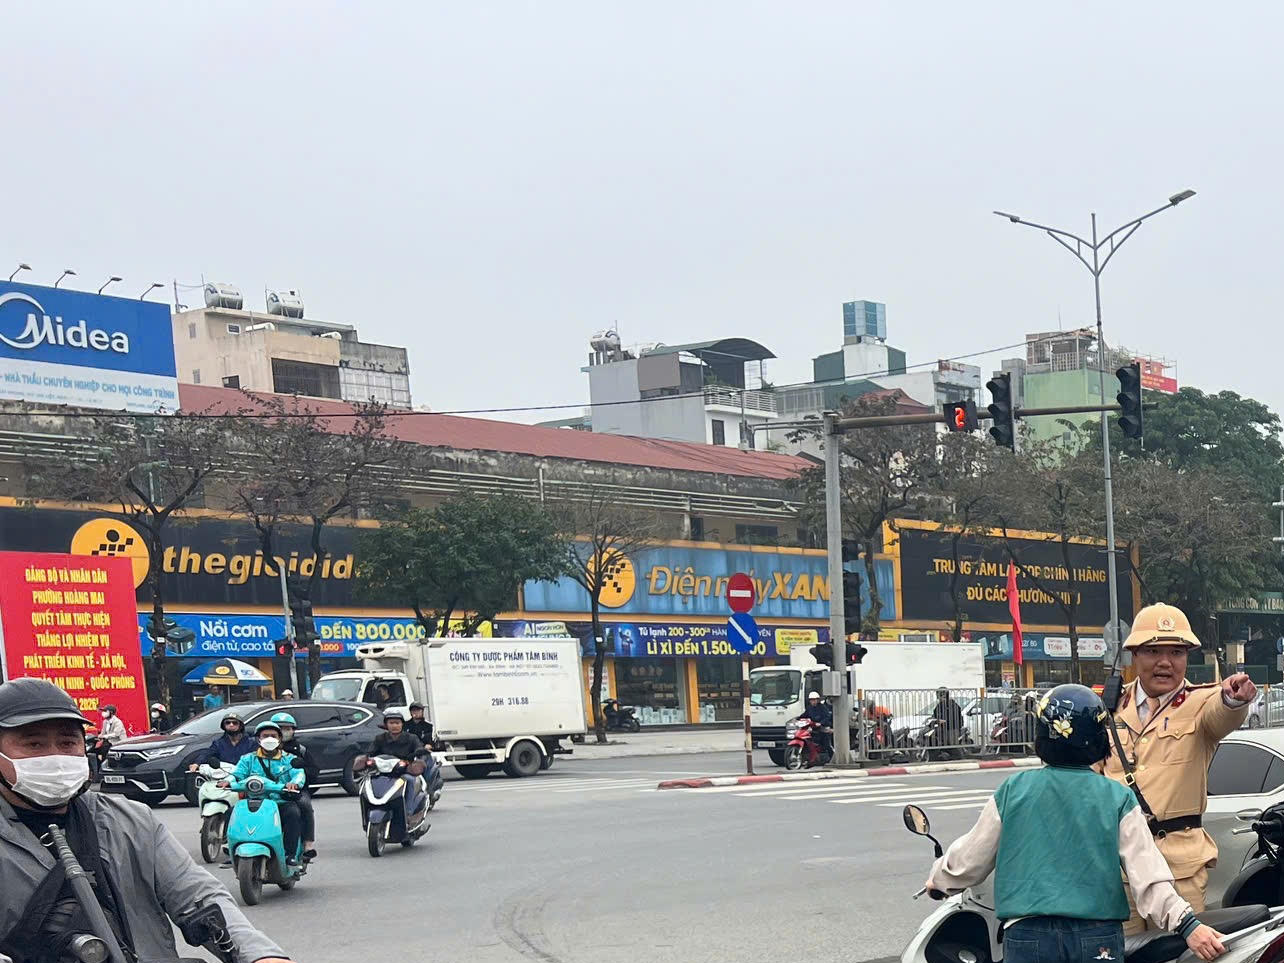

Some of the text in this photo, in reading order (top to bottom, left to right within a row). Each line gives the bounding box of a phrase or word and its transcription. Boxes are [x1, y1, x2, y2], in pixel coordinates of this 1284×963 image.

[15, 312, 130, 354] Midea
[25, 565, 47, 582] ĐẢNG
[59, 567, 70, 582] VÀ
[70, 567, 91, 583] NHÂN
[92, 568, 108, 584] DÂN
[645, 565, 712, 604] Điện
[985, 584, 1008, 602] CÁC
[32, 588, 105, 605] PHƯỜNG HOÀNG MAI
[32, 609, 111, 628] QUYẾT TÂM THỰC HIỆN
[200, 619, 268, 638] Nồi cơm
[320, 621, 353, 640] ĐẾN
[638, 626, 649, 637] Tủ
[649, 627, 667, 640] lạnh
[36, 630, 62, 648] THẮNG
[75, 632, 100, 649] NHIỆM
[100, 634, 111, 650] VỤ
[201, 640, 225, 653] điện
[241, 641, 262, 652] cao
[647, 638, 659, 655] LÌ
[659, 639, 672, 655] XÌ
[674, 636, 700, 655] ĐẾN
[23, 653, 43, 669] PHÁT
[43, 651, 66, 669] TRIỂN
[67, 655, 85, 669] KINH
[86, 651, 96, 669] TẾ
[449, 650, 470, 662] CÔNG
[471, 652, 481, 661] TY
[482, 651, 502, 662] DƯỢC
[525, 650, 540, 661] TÂM
[541, 650, 559, 661] BÌNH
[65, 676, 85, 690] NINH
[90, 672, 110, 691] QUỐC
[111, 673, 136, 689] PHÒNG
